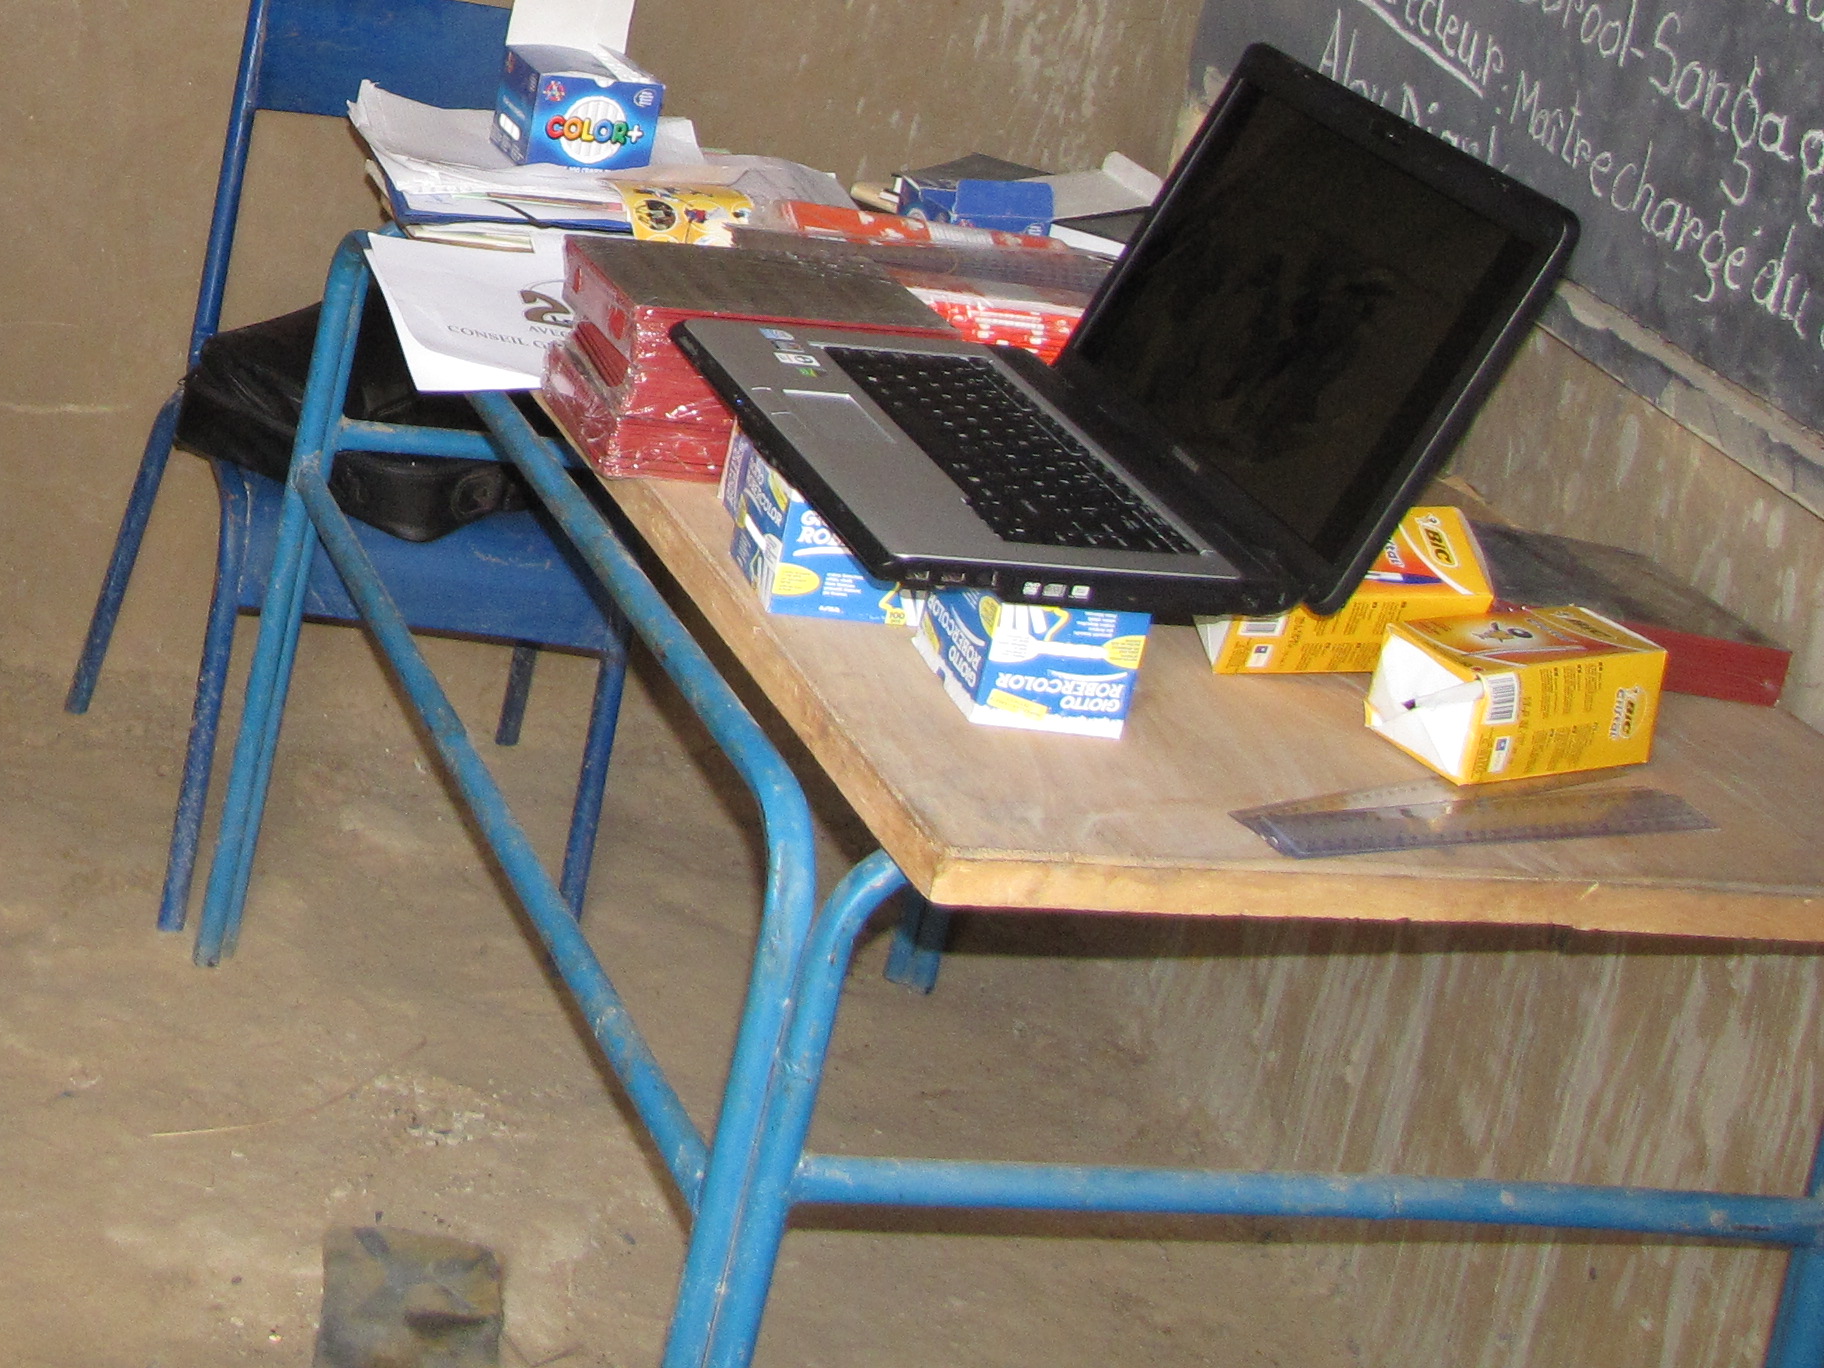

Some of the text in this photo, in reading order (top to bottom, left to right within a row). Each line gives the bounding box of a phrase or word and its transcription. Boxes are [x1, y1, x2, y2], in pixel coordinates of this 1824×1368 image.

[1750, 222, 1813, 341] du
[447, 324, 529, 348] CONSEIL
[1424, 524, 1452, 565] BIC
[948, 645, 978, 688] GIOTTO
[995, 671, 1126, 699] ROBERCOLOR
[1059, 695, 1121, 713] GIOTTO
